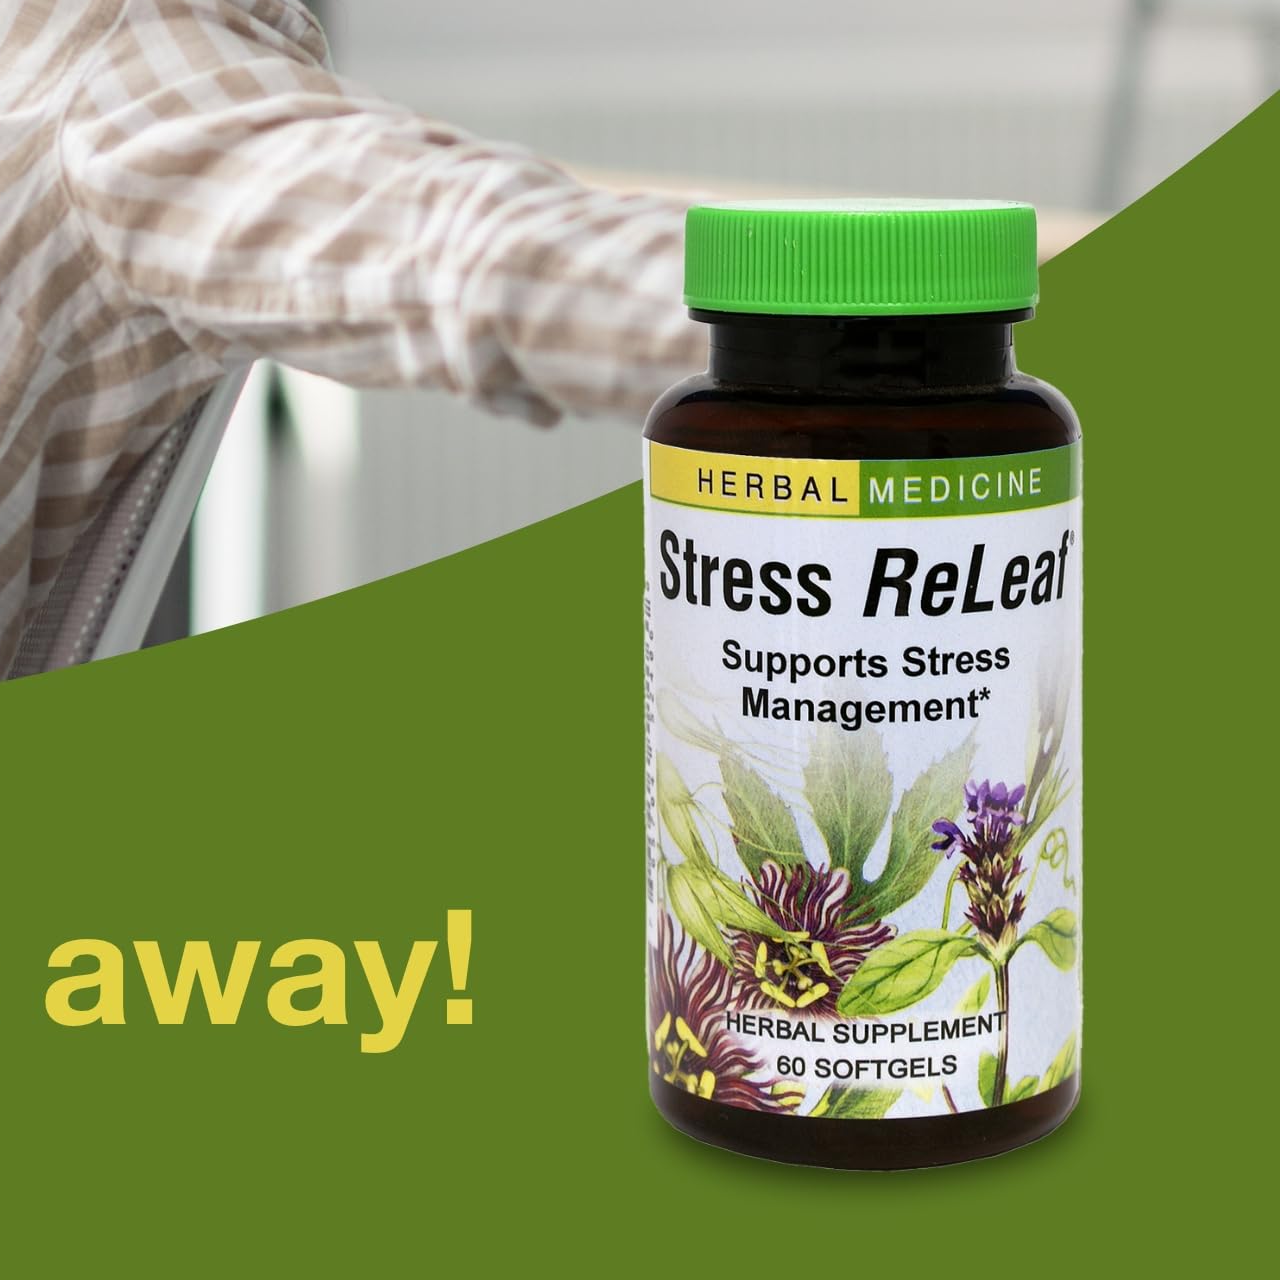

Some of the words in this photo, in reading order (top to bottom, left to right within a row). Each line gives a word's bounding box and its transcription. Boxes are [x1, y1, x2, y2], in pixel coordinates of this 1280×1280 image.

[697, 468, 848, 503] HERBAL
[869, 467, 1043, 505] MEDICINE
[659, 529, 832, 617] Stress
[721, 638, 889, 683] Supports
[901, 646, 1011, 677] Stress
[725, 1011, 826, 1044] HERBAL
[832, 1010, 1008, 1045] SUPPLEMENT
[776, 1054, 806, 1078] 60
[814, 1054, 958, 1080] SOFTGELS
